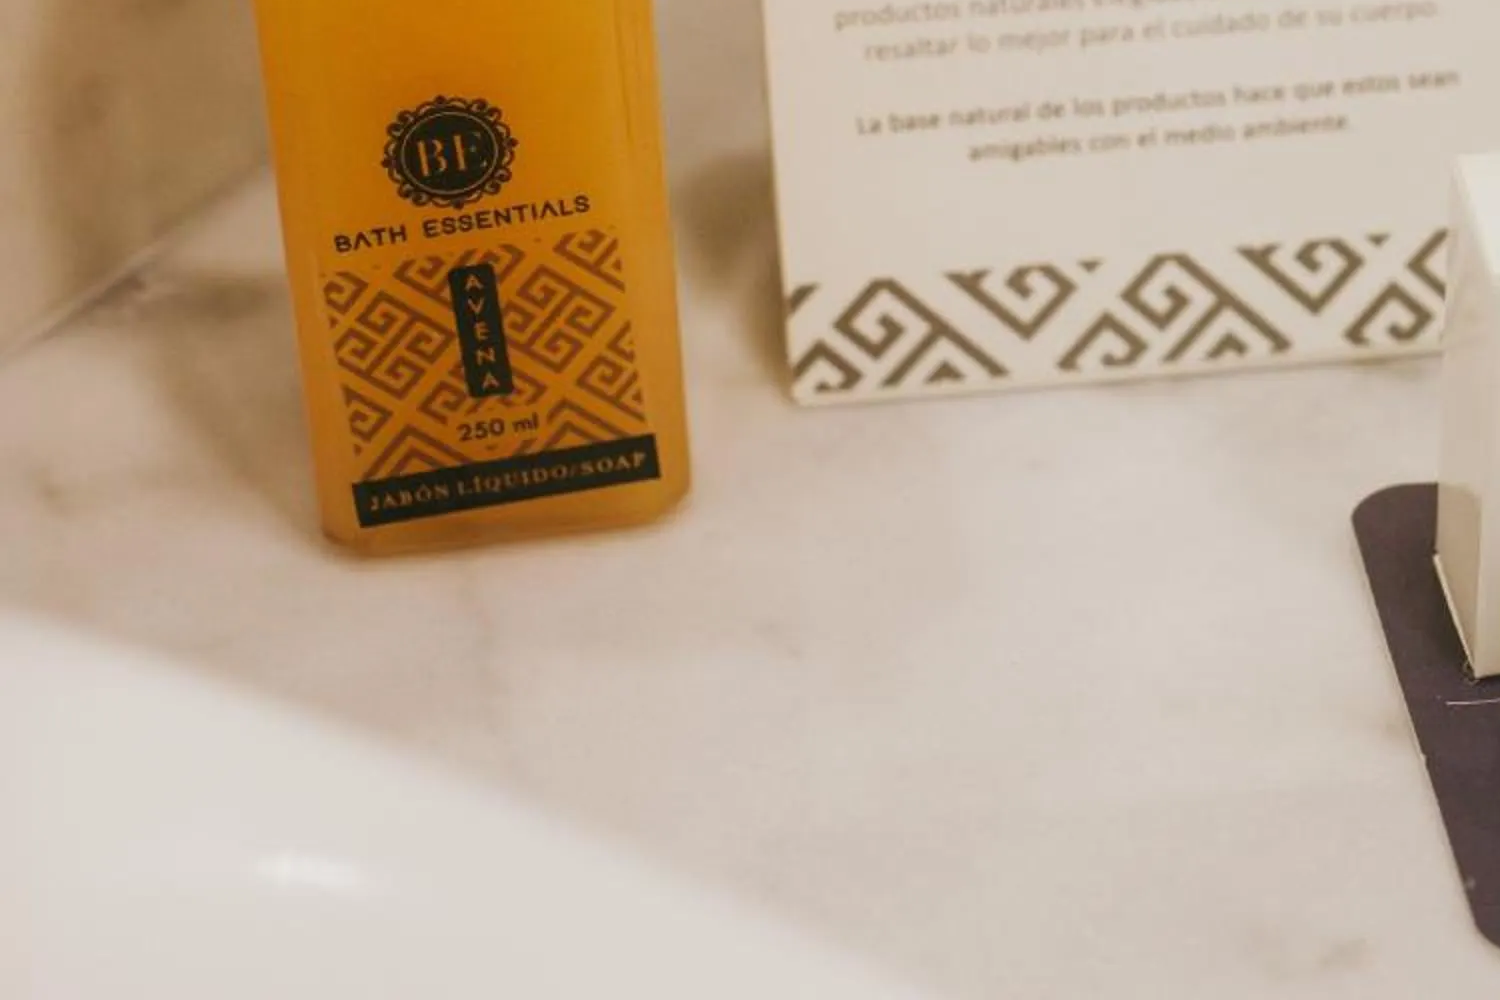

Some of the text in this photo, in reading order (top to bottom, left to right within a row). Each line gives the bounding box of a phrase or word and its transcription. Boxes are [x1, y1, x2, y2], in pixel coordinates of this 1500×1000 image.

[834, 3, 960, 32] productos
[863, 36, 957, 62] resaltar
[966, 31, 992, 53] lo
[998, 29, 1071, 56] mejor
[1079, 25, 1134, 50] para
[1142, 16, 1165, 40] el
[1170, 11, 1271, 38] cuidado
[1278, 9, 1307, 30] de
[1315, 8, 1343, 27] su
[855, 69, 1461, 135] La base natural de los productos hace que estos sean
[416, 130, 488, 178] BE
[968, 135, 1081, 162] amigables
[1088, 134, 1131, 153] con
[1137, 127, 1157, 149] el
[1164, 124, 1236, 145] medio
[334, 195, 591, 253] BATH ESSENTIALS
[463, 272, 501, 390] AVENA
[456, 413, 539, 443] 250 ml
[369, 482, 449, 512] JABÓN
